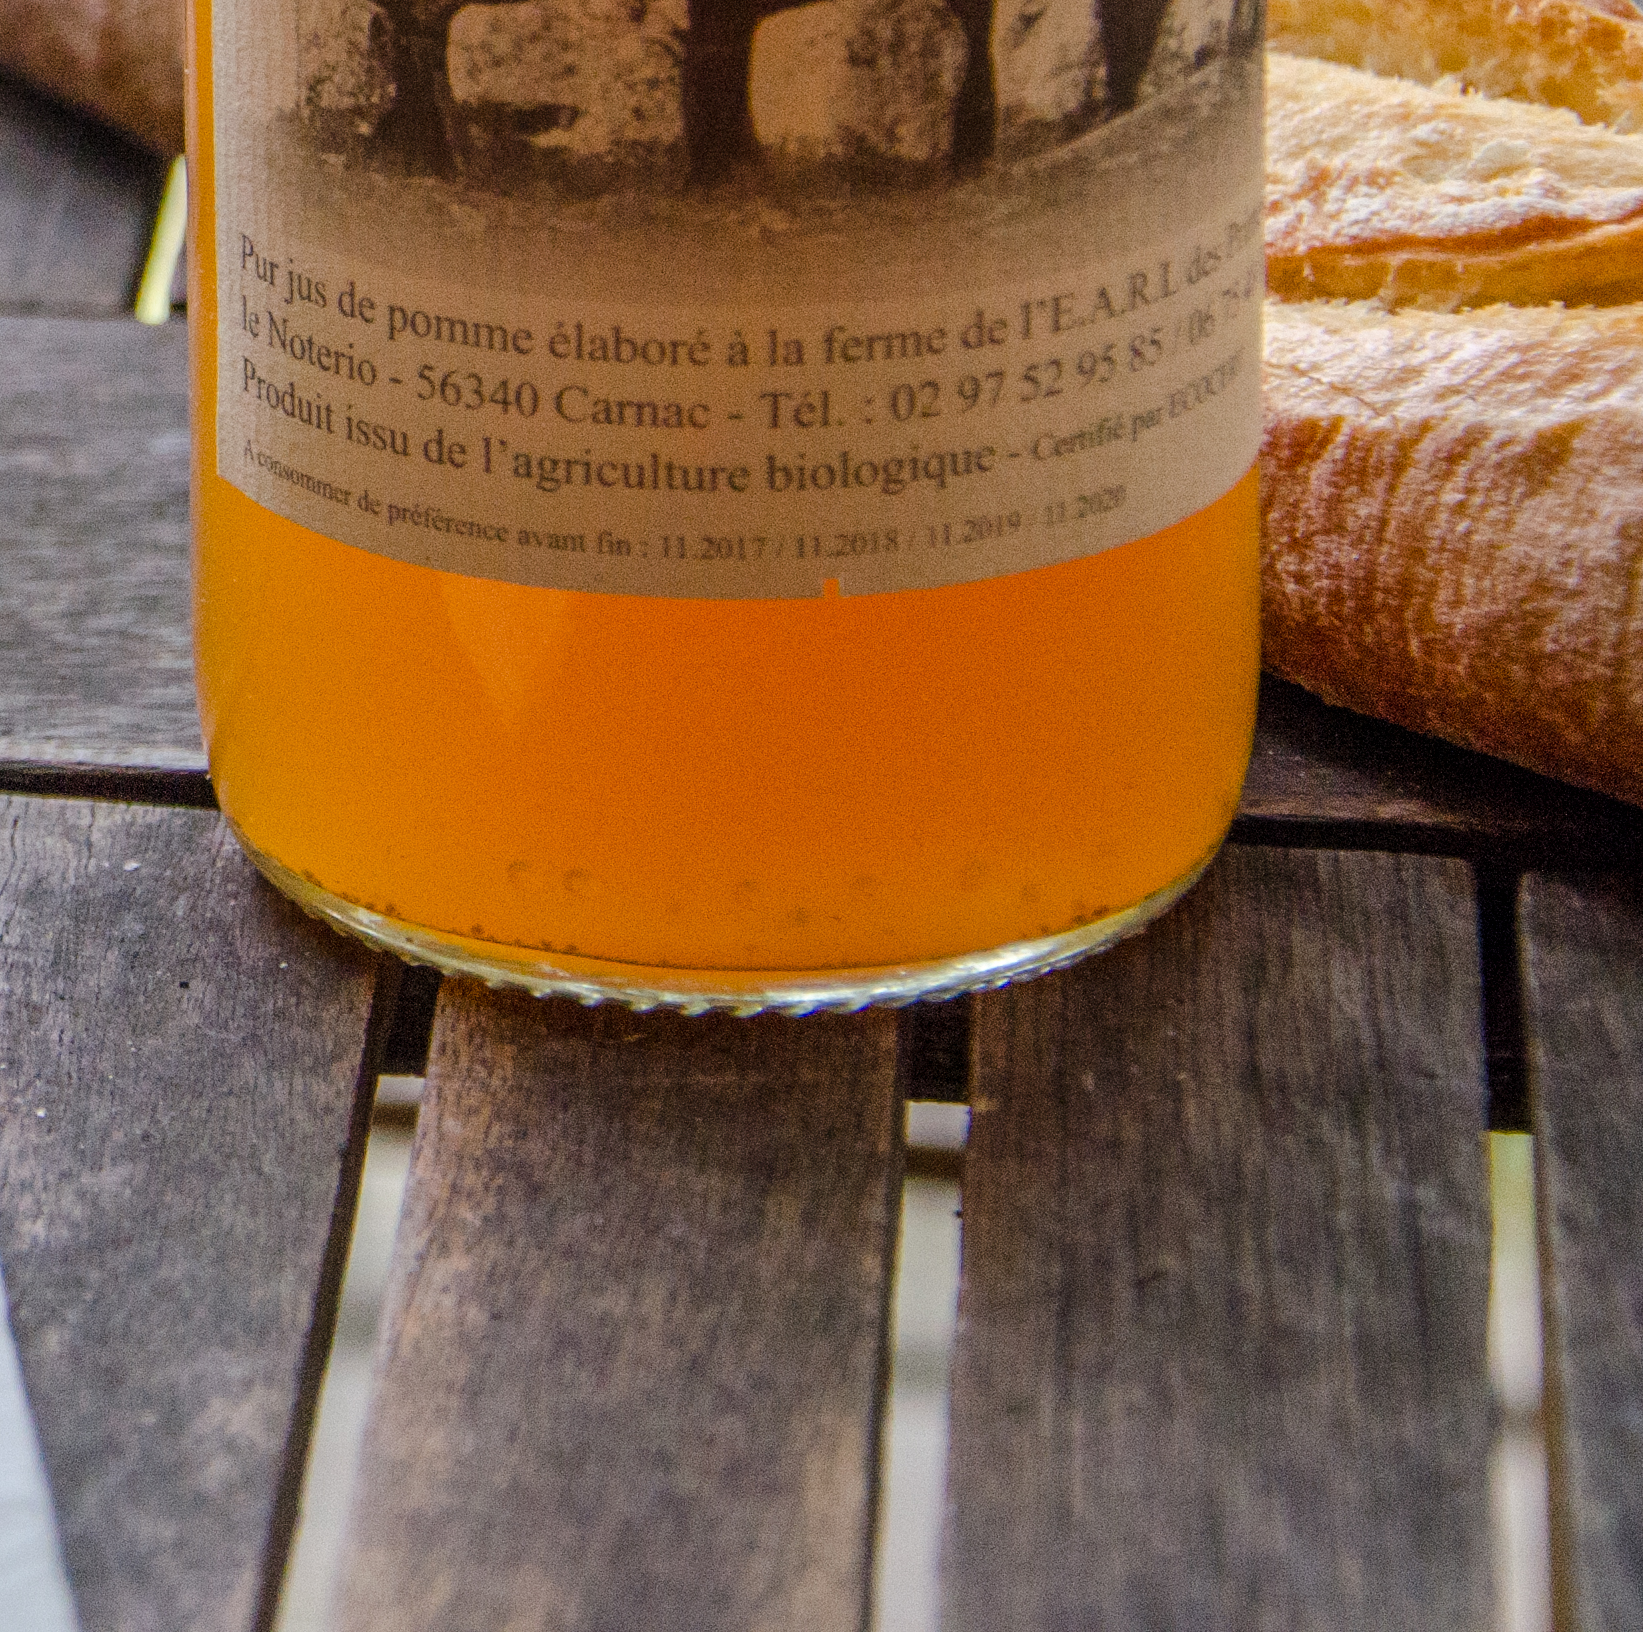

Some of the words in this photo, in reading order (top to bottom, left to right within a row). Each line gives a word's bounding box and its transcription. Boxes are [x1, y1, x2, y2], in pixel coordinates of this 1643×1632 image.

[241, 294, 260, 338] le
[268, 310, 377, 386] Noterio
[417, 364, 538, 418] 56340
[555, 384, 709, 430] Carnac
[761, 390, 842, 429] Tél.
[891, 380, 941, 421] 02
[957, 369, 1005, 414] 97
[1021, 358, 1062, 404] 52
[1076, 342, 1116, 389] 95
[1129, 325, 1162, 373] 85
[242, 233, 279, 285] Pur
[284, 258, 327, 308] jus
[337, 279, 376, 324] de
[387, 298, 535, 355] pomme
[547, 321, 712, 367] élaboré
[725, 330, 750, 367] à
[767, 328, 805, 366] la
[823, 324, 947, 365] ferme
[961, 306, 1007, 351] de
[242, 355, 334, 435] Produit
[346, 404, 411, 457] issu
[422, 428, 467, 469] de
[765, 440, 996, 496] biologique
[258, 449, 352, 507] consommer
[358, 489, 381, 516] de
[387, 501, 511, 544] préférence
[517, 519, 587, 555] avant
[598, 529, 632, 557] fin
[661, 533, 767, 561] 11.2017
[796, 526, 899, 560] 11.2018
